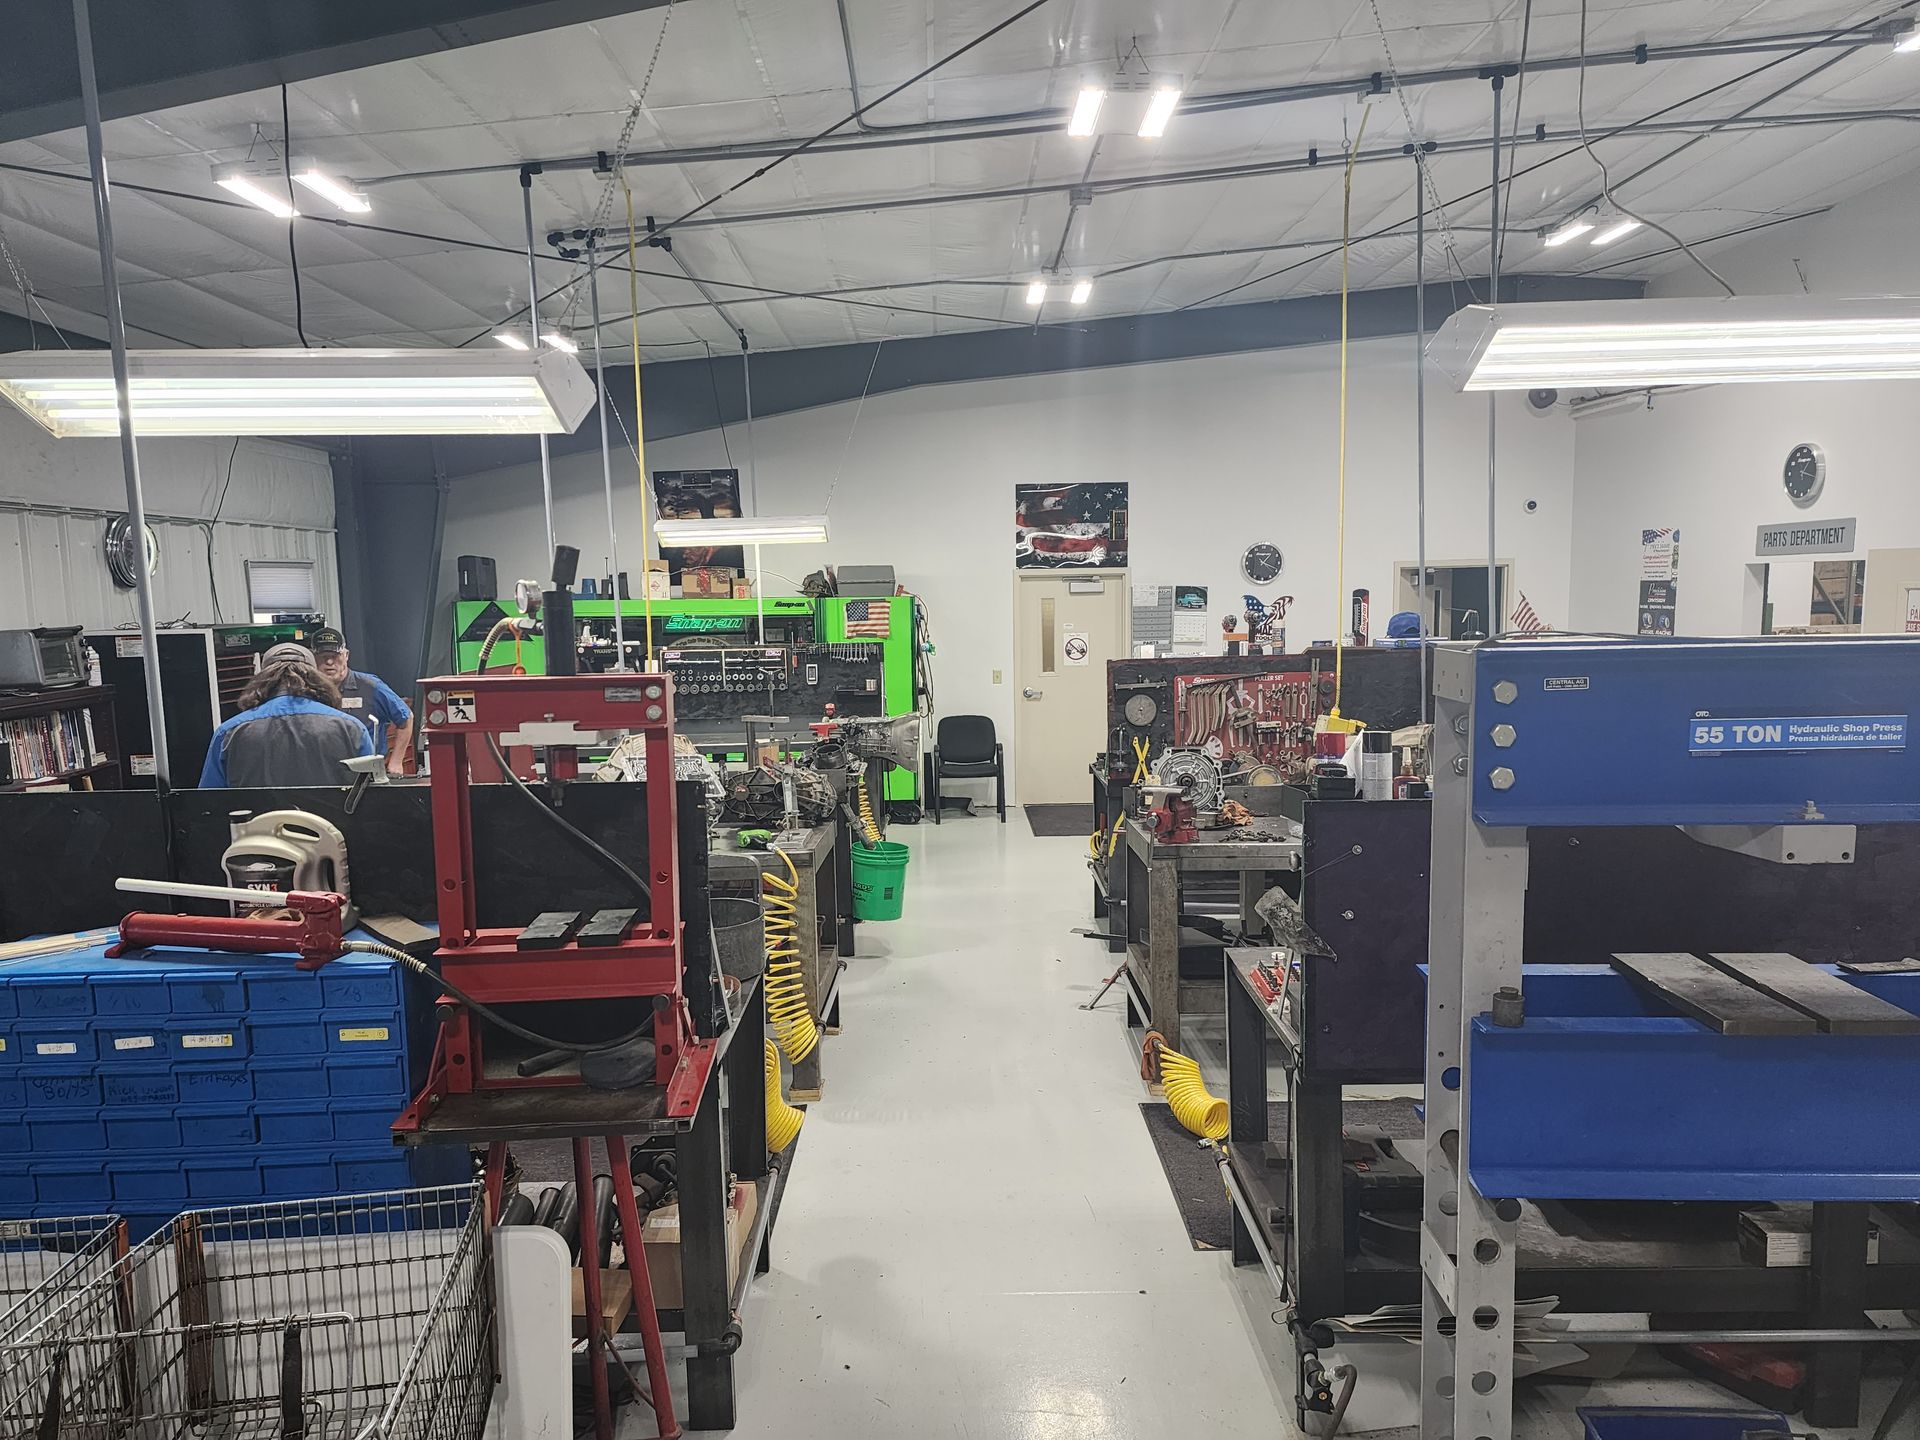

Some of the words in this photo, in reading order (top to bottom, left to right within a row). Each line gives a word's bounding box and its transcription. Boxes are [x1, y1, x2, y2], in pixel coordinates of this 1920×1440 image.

[1763, 532, 1787, 548] PARTS
[1790, 526, 1846, 547] DEPARTMENT
[774, 601, 806, 609] Snap-on
[665, 613, 743, 632] Snap-on
[1789, 724, 1839, 734] Hydraulic
[1842, 724, 1869, 734] Shop
[1873, 723, 1903, 732] Press
[1694, 726, 1724, 744] 55
[1732, 725, 1782, 743] TON
[1821, 733, 1864, 742] hidráulica
[1865, 733, 1876, 741] de
[1879, 733, 1902, 741] taller
[247, 883, 278, 892] SYN3
